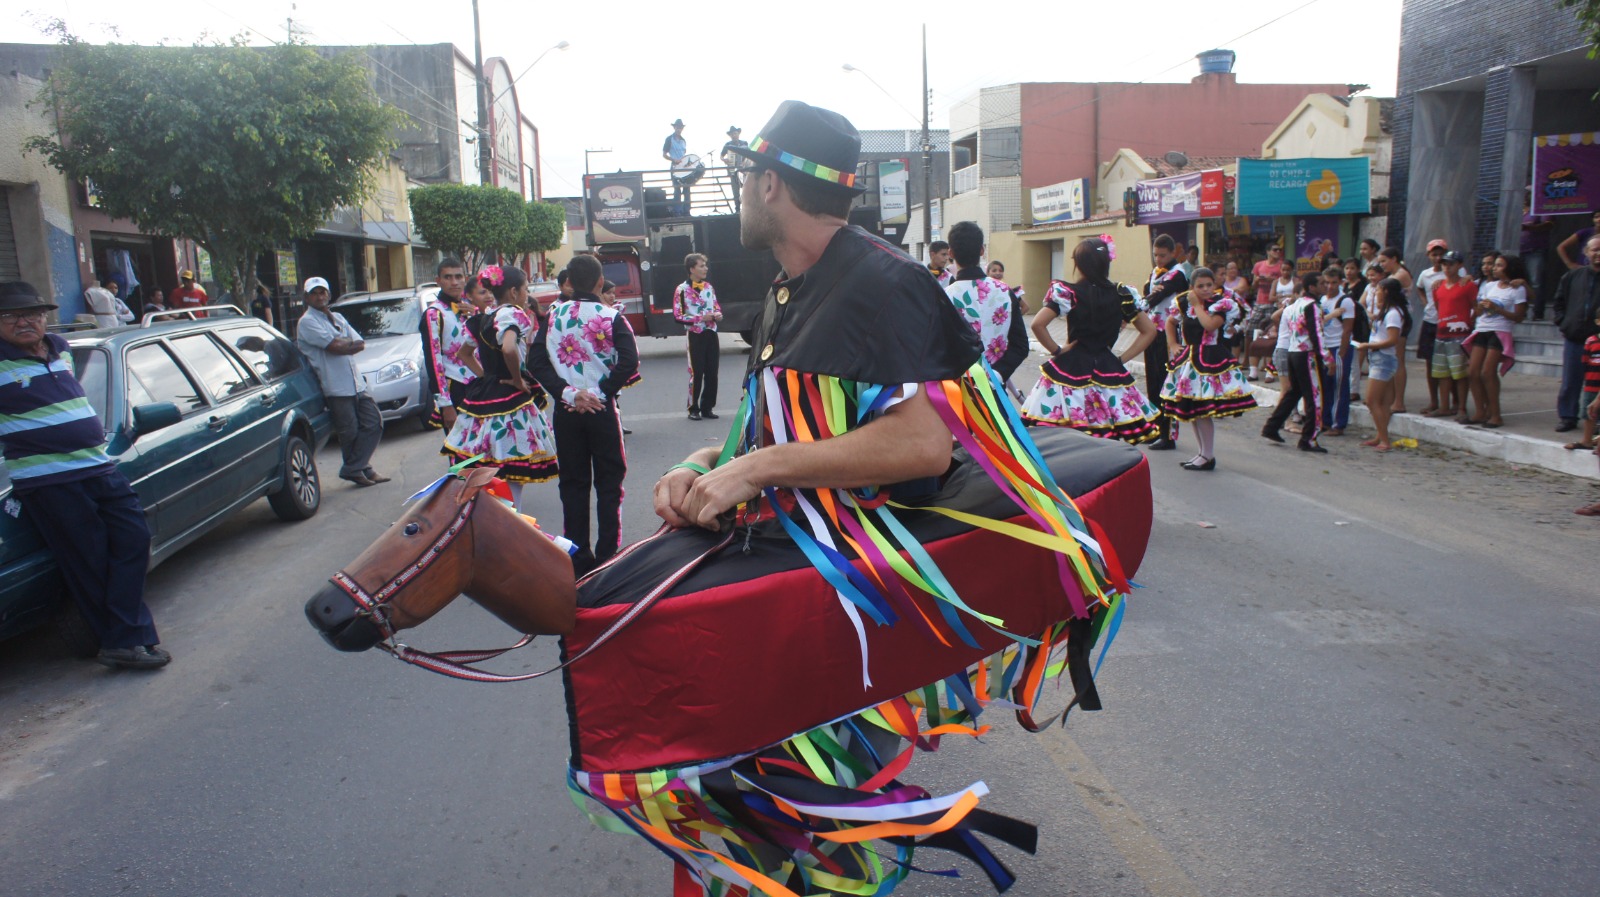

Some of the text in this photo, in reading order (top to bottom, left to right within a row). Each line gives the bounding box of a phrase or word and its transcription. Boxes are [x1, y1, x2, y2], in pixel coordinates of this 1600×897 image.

[1269, 170, 1311, 178] OI CHIP E
[1269, 180, 1308, 188] RECARGA
[1318, 185, 1336, 204] oi
[1138, 202, 1160, 212] SEMPRE
[1296, 220, 1305, 244] vivo
